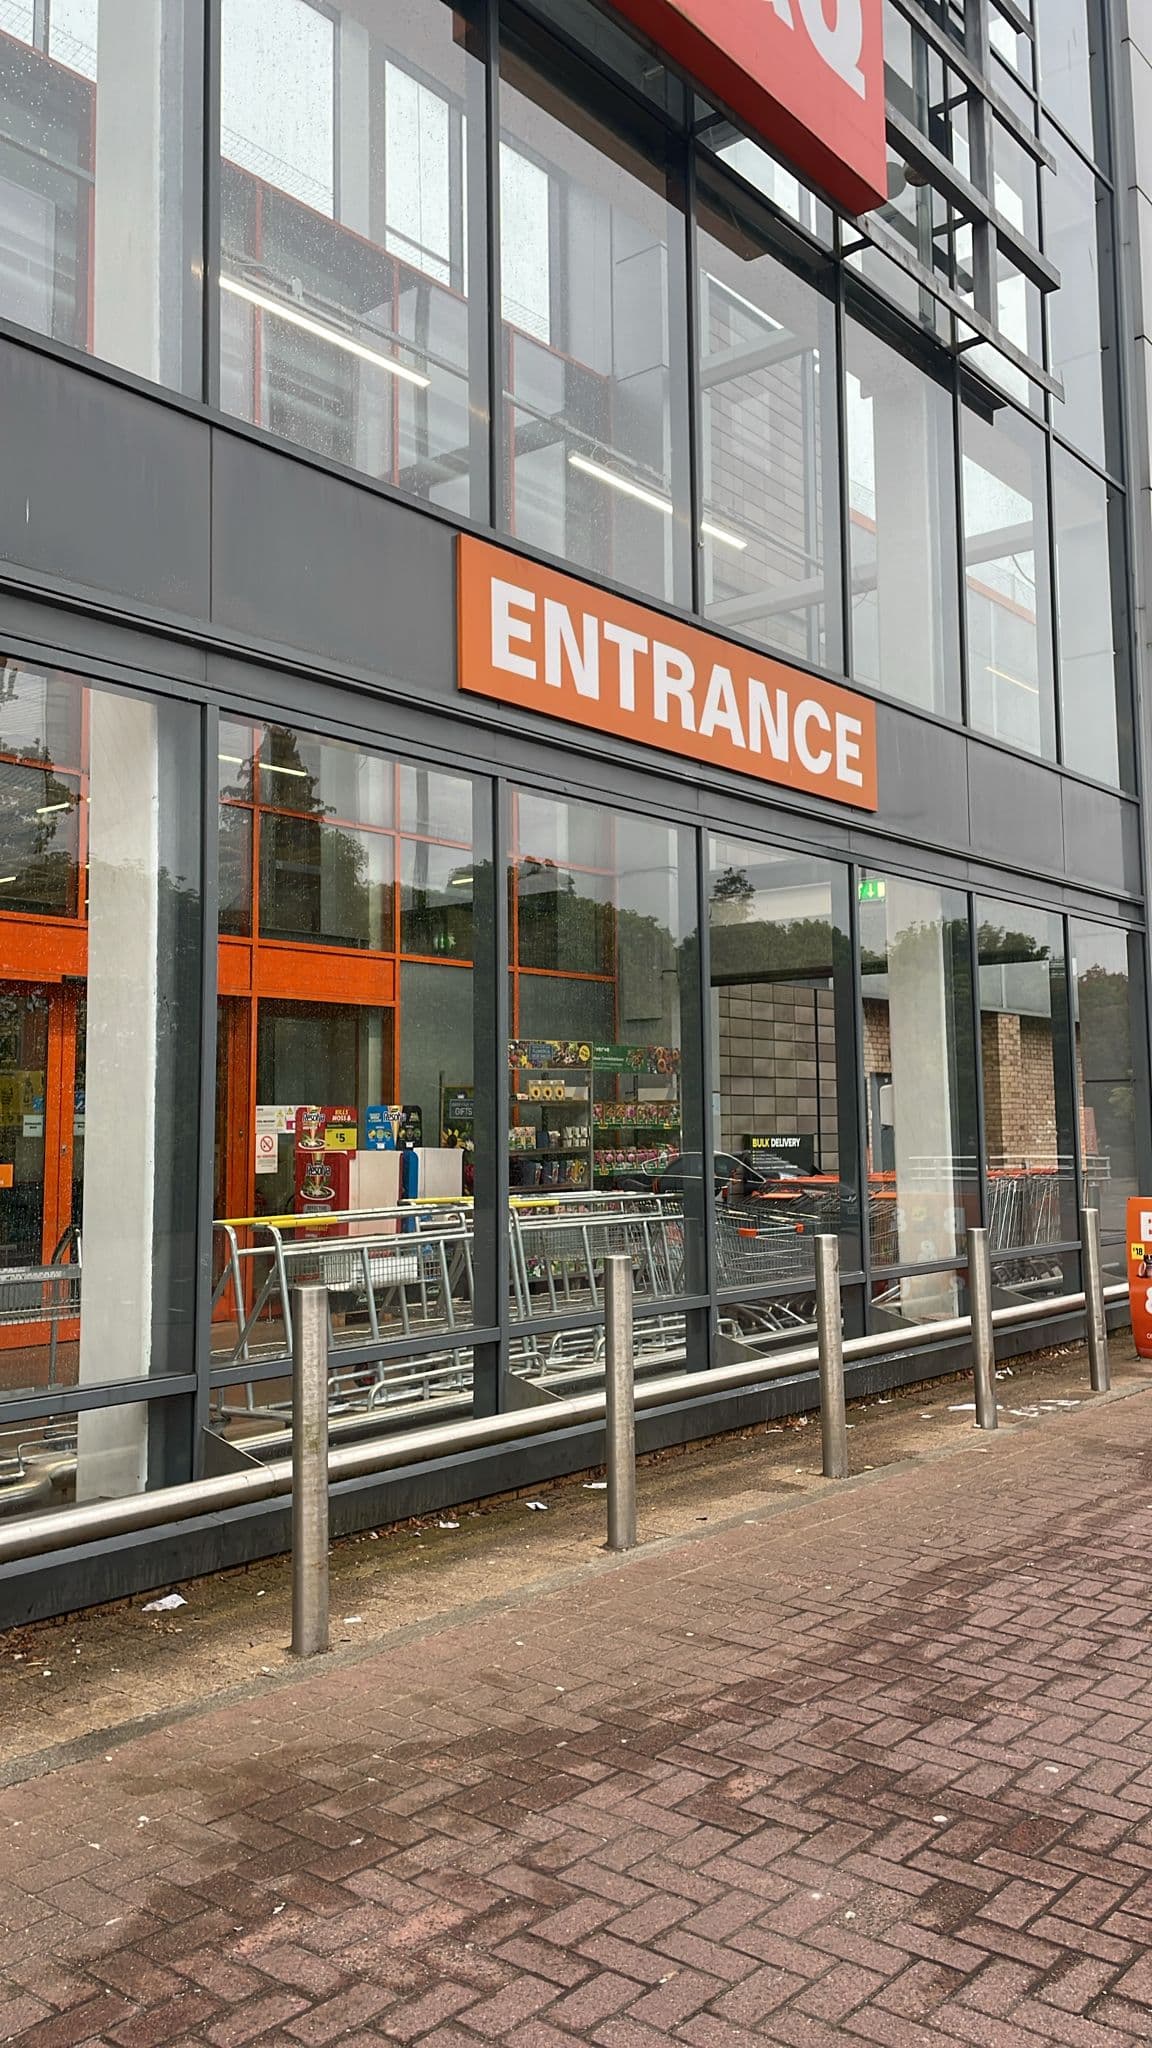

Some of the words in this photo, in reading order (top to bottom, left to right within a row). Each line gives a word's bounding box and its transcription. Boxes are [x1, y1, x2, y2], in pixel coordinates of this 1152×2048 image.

[490, 576, 863, 788] ENTRANCE
[454, 1107, 472, 1116] GIFTS
[335, 1133, 346, 1143] £5
[752, 1138, 770, 1148] BULK
[771, 1137, 801, 1148] DELIVERY
[1132, 1247, 1143, 1256] £18
